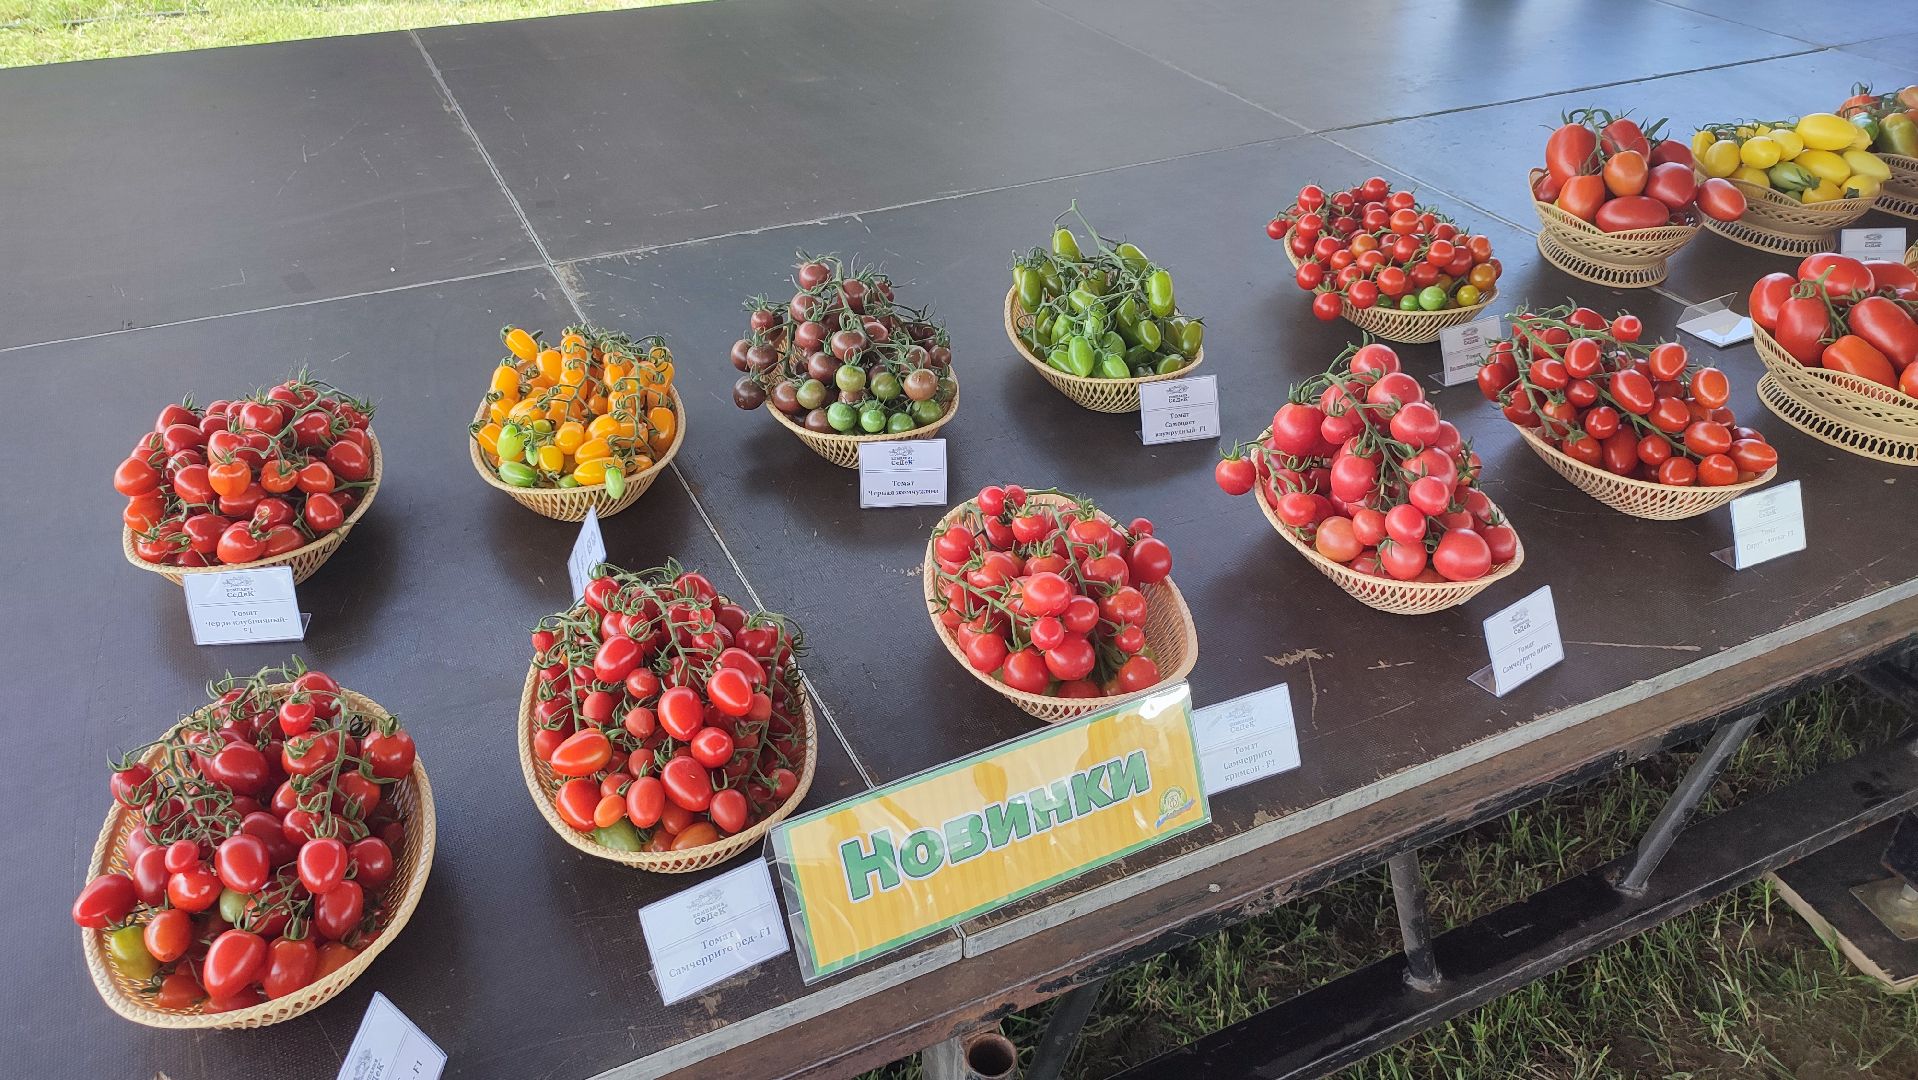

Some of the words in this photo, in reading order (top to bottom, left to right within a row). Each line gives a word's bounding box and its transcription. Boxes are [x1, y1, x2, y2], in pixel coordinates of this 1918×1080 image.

[1518, 641, 1535, 653] Томат
[1502, 652, 1537, 674] Самчеррито
[1233, 743, 1258, 755] Томат
[1223, 749, 1273, 770] Самчеррито
[1224, 765, 1260, 782] кримсон
[694, 907, 727, 925] СеДеК
[701, 930, 736, 949] Томат
[668, 945, 734, 978] Самчеррито
